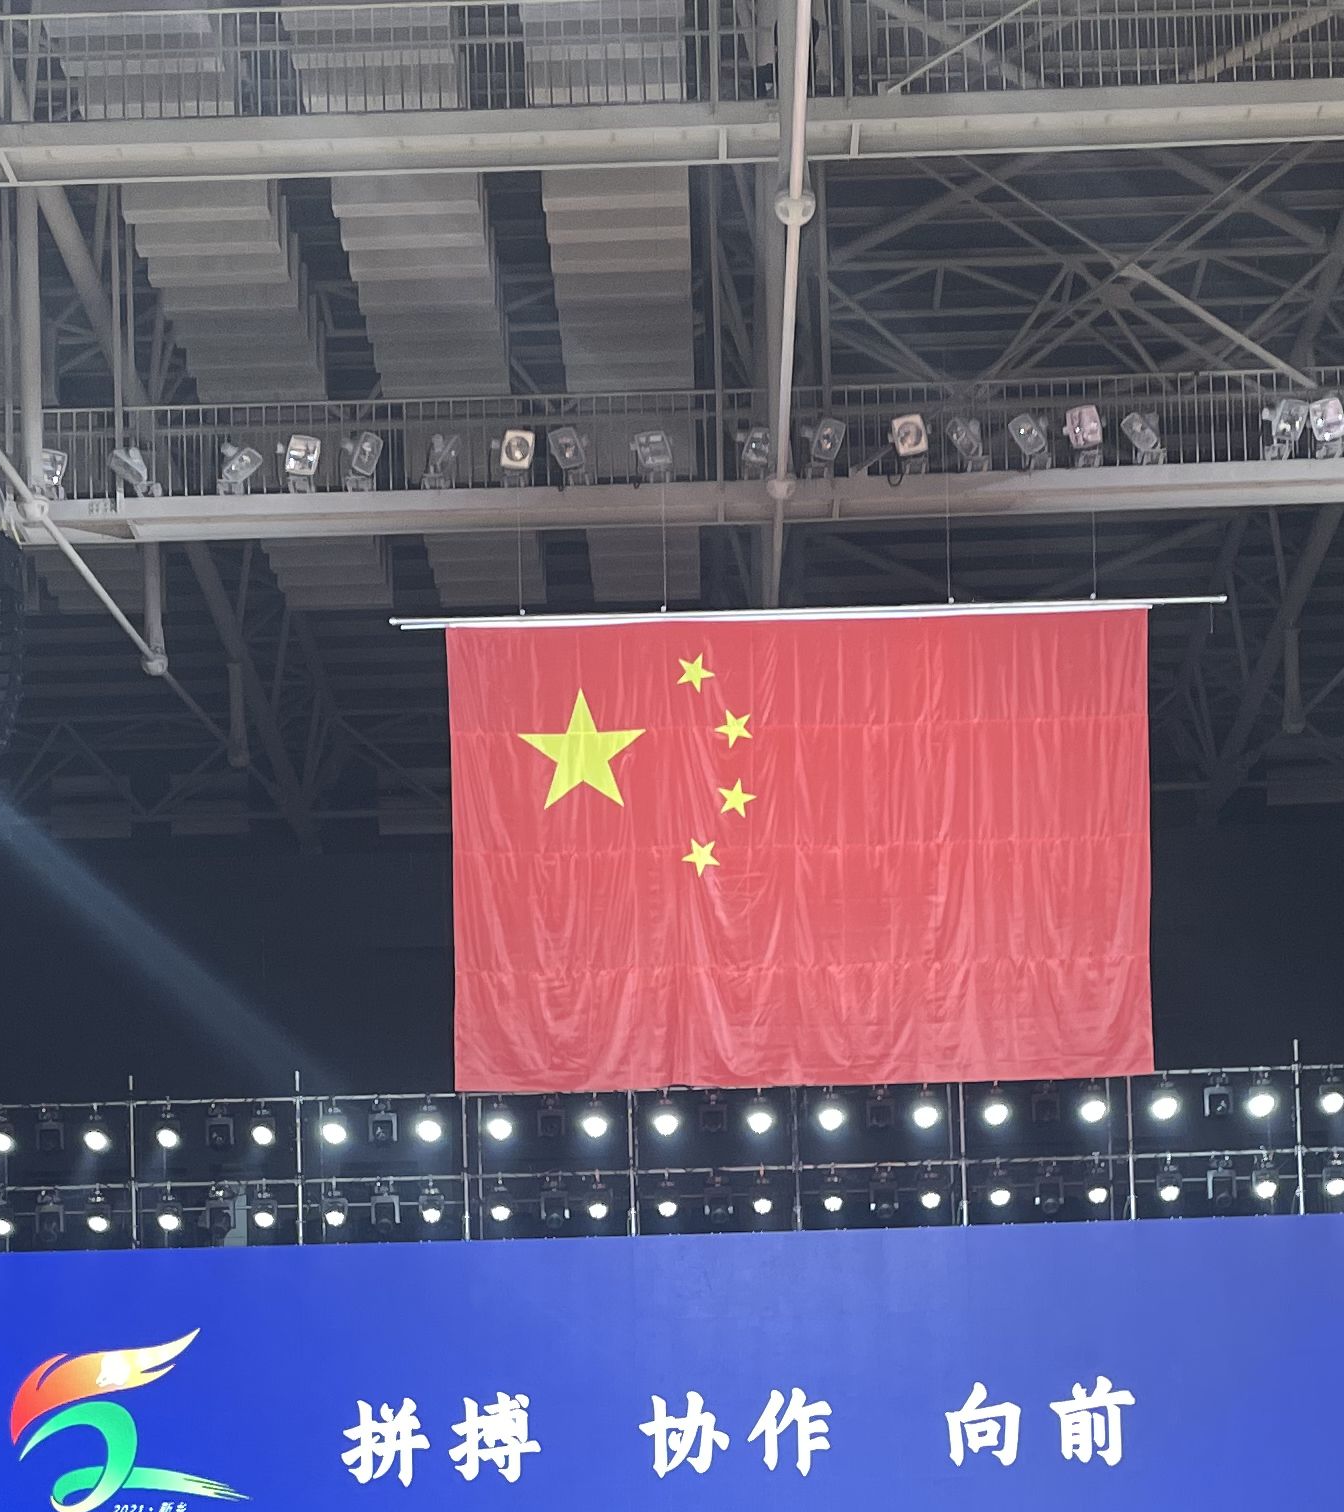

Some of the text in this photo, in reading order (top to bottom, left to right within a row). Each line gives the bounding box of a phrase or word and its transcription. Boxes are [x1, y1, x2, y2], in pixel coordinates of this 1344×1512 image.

[342, 1376, 1135, 1487] 拼搏 协作 向前
